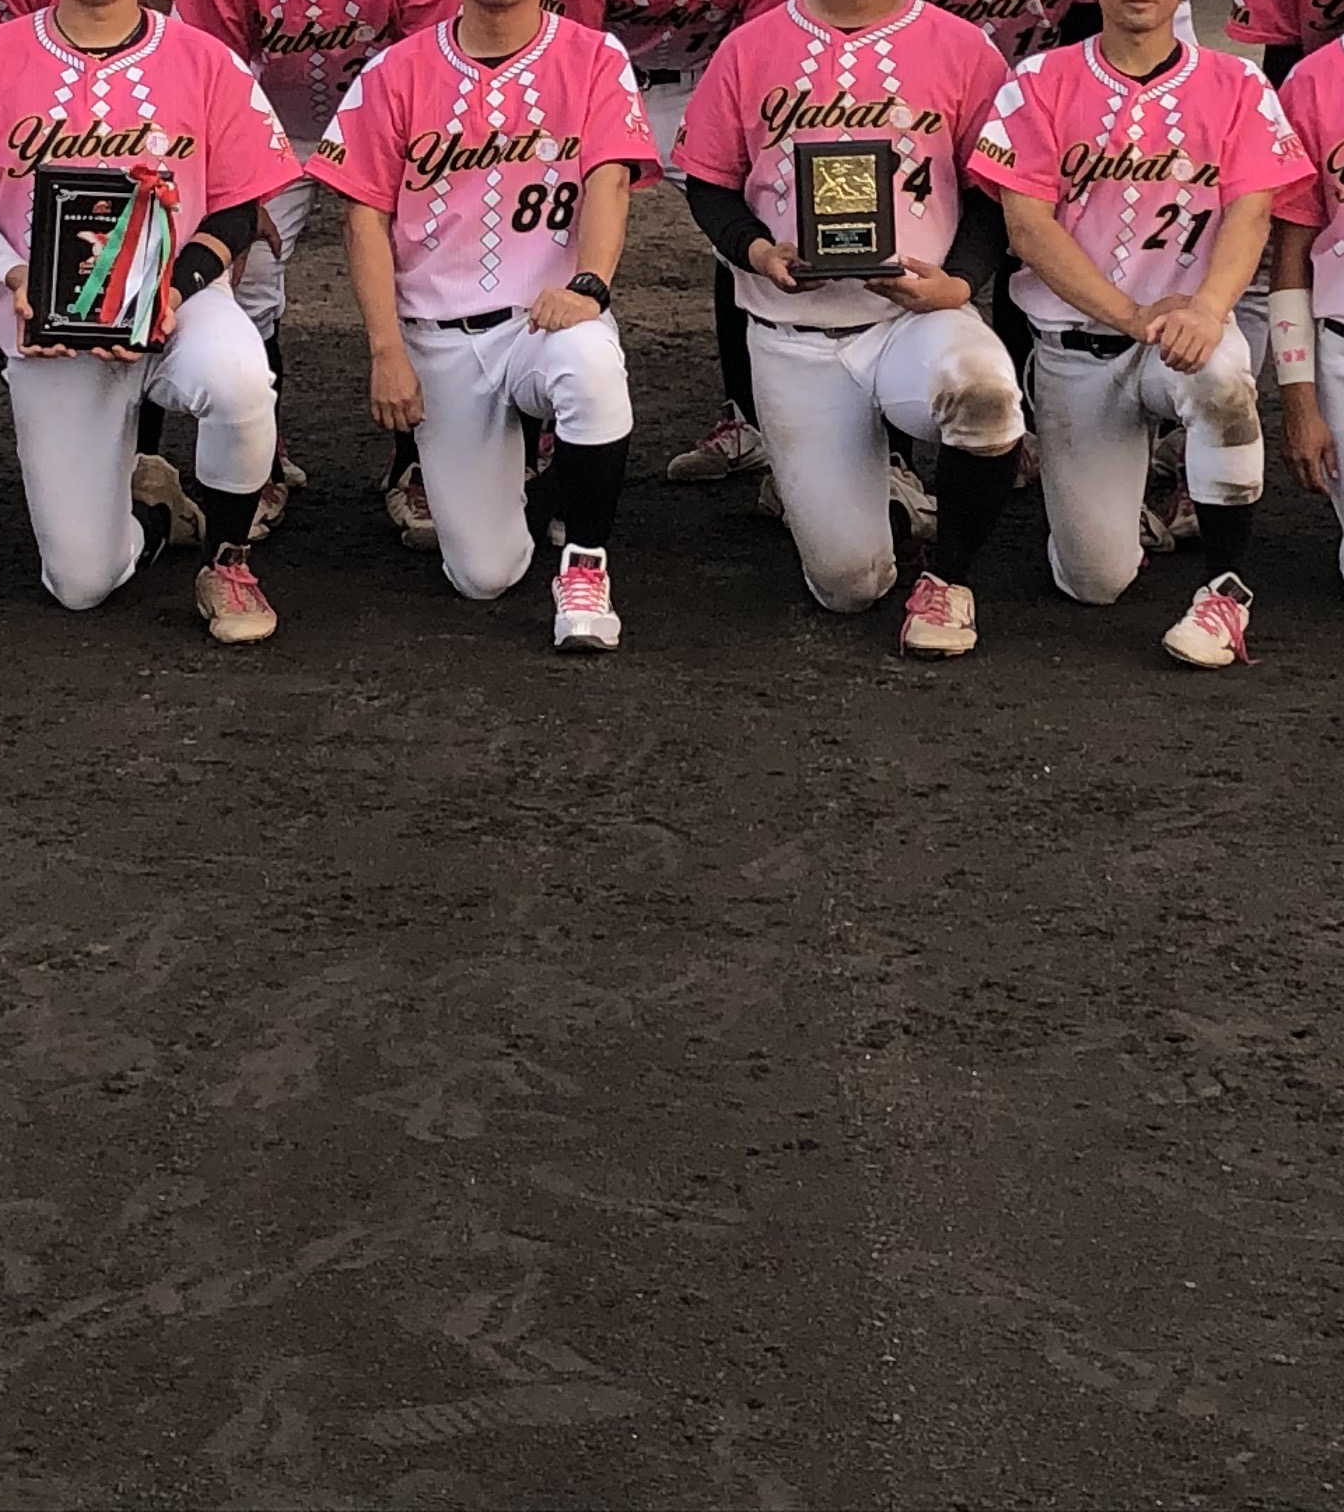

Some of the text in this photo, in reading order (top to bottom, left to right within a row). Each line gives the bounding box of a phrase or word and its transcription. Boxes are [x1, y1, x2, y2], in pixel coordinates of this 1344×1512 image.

[7, 115, 195, 178] Yabaton
[760, 87, 943, 149] Yabaton
[406, 130, 580, 191] Yabaton
[892, 151, 933, 202] 4
[1061, 143, 1221, 203] Yabaton
[511, 181, 579, 233] 88
[1142, 203, 1213, 254] 21
